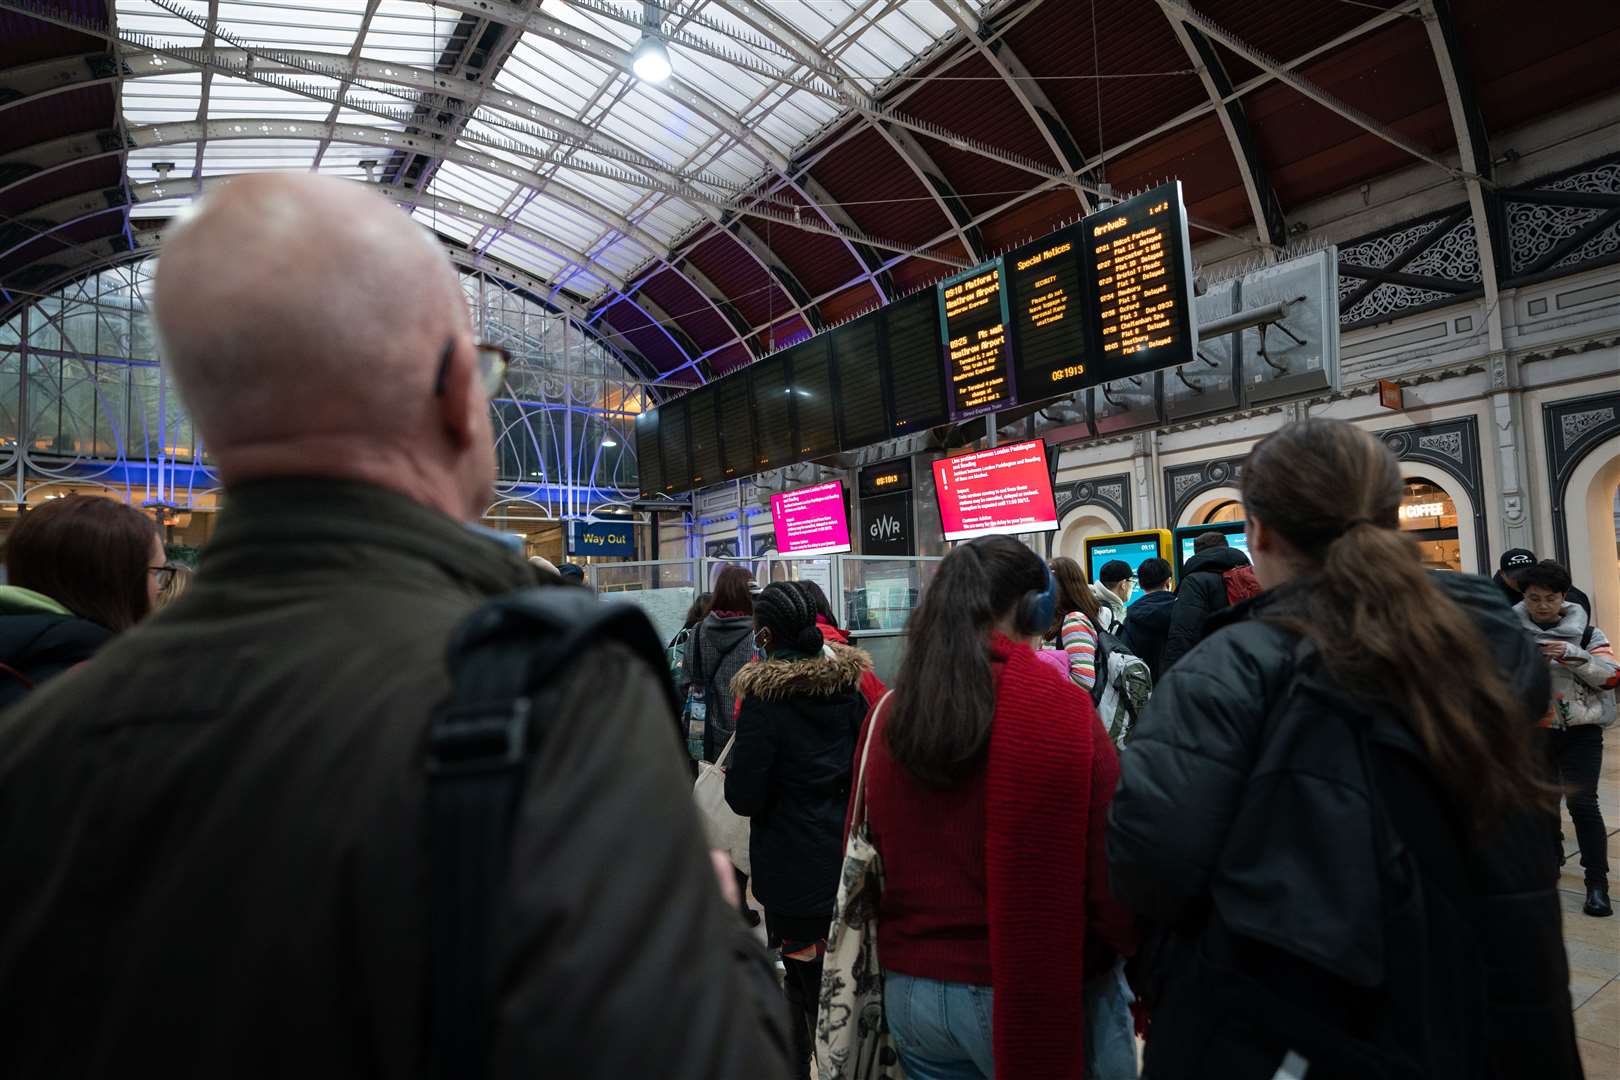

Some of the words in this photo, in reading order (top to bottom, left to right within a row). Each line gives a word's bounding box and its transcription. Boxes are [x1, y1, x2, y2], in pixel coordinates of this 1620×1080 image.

[1155, 205, 1161, 213] of
[1094, 218, 1127, 236] Arrivals
[1114, 236, 1130, 247] Didcot
[1132, 228, 1155, 240] Parkway
[1114, 247, 1126, 255] Plat
[1139, 233, 1162, 246] Delayed
[1018, 254, 1041, 270] Special
[1043, 244, 1070, 260] Notices
[1115, 250, 1143, 263] Worcester
[1116, 263, 1127, 272] Plat
[1141, 250, 1163, 263] Delayed
[1117, 269, 1136, 280] Bristol
[1143, 261, 1160, 271] Meads
[945, 285, 962, 298] 09:10
[965, 275, 992, 290] Platform
[993, 271, 998, 279] 6
[1035, 276, 1056, 287] SECURITY
[1117, 280, 1129, 288] Plat
[1143, 268, 1164, 280] Delayed
[946, 293, 974, 309] Heathrow
[976, 282, 999, 298] Airport
[1118, 286, 1141, 296] Newbury
[1144, 285, 1166, 296] Delayed
[1032, 296, 1046, 304] Please
[1043, 299, 1060, 308] luggage
[948, 306, 968, 317] Heathrow
[969, 298, 988, 309] Express
[1119, 302, 1139, 312] Oxford
[1032, 309, 1052, 320] personal
[1037, 313, 1063, 326] unattended
[1120, 313, 1132, 321] Plat
[1121, 317, 1152, 329] Cheltenham
[1147, 320, 1170, 330] Delayed
[950, 336, 967, 349] 09:25
[978, 330, 988, 339] Pls
[1122, 335, 1148, 346] Westbury
[1148, 336, 1171, 348] Delayed
[951, 345, 979, 359] Heathrow
[981, 336, 1004, 350] Airport
[954, 371, 974, 381] Heathrow
[1010, 444, 1036, 452] Paddington
[1407, 502, 1444, 518] COFFEE
[870, 513, 901, 540] GWR
[583, 533, 605, 546] Way
[607, 534, 626, 545] Out
[1093, 547, 1117, 556] Departures
